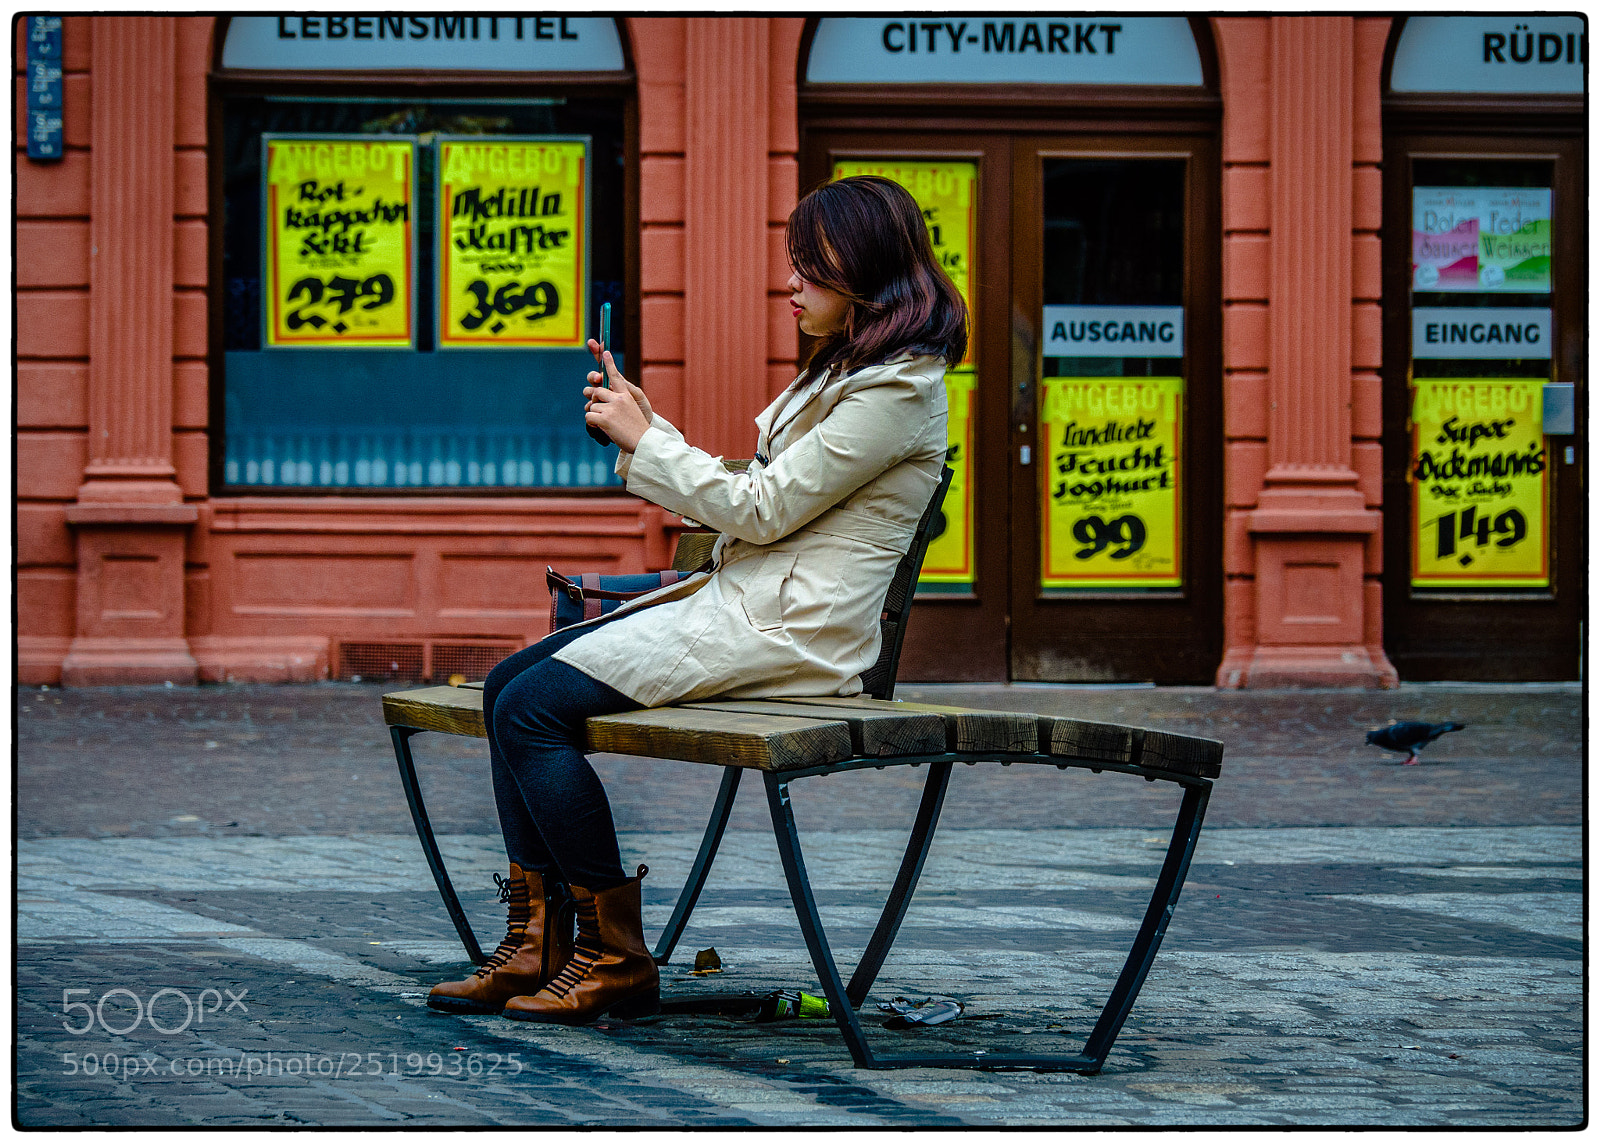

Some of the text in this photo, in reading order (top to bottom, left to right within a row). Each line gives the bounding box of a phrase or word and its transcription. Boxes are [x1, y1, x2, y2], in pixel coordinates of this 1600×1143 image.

[277, 16, 579, 40] LEBENSMITTEL
[882, 22, 1123, 55] CITY-MARKT
[1483, 24, 1584, 64] RÜDI
[269, 142, 411, 184] ANGEBOT
[443, 143, 585, 187] ANGEBOT
[1051, 320, 1175, 343] AUSGANG
[1425, 323, 1541, 344] EINGANG
[1042, 379, 1183, 423] ANGEBOT
[1437, 415, 1515, 449] Super
[1072, 514, 1147, 560] 99
